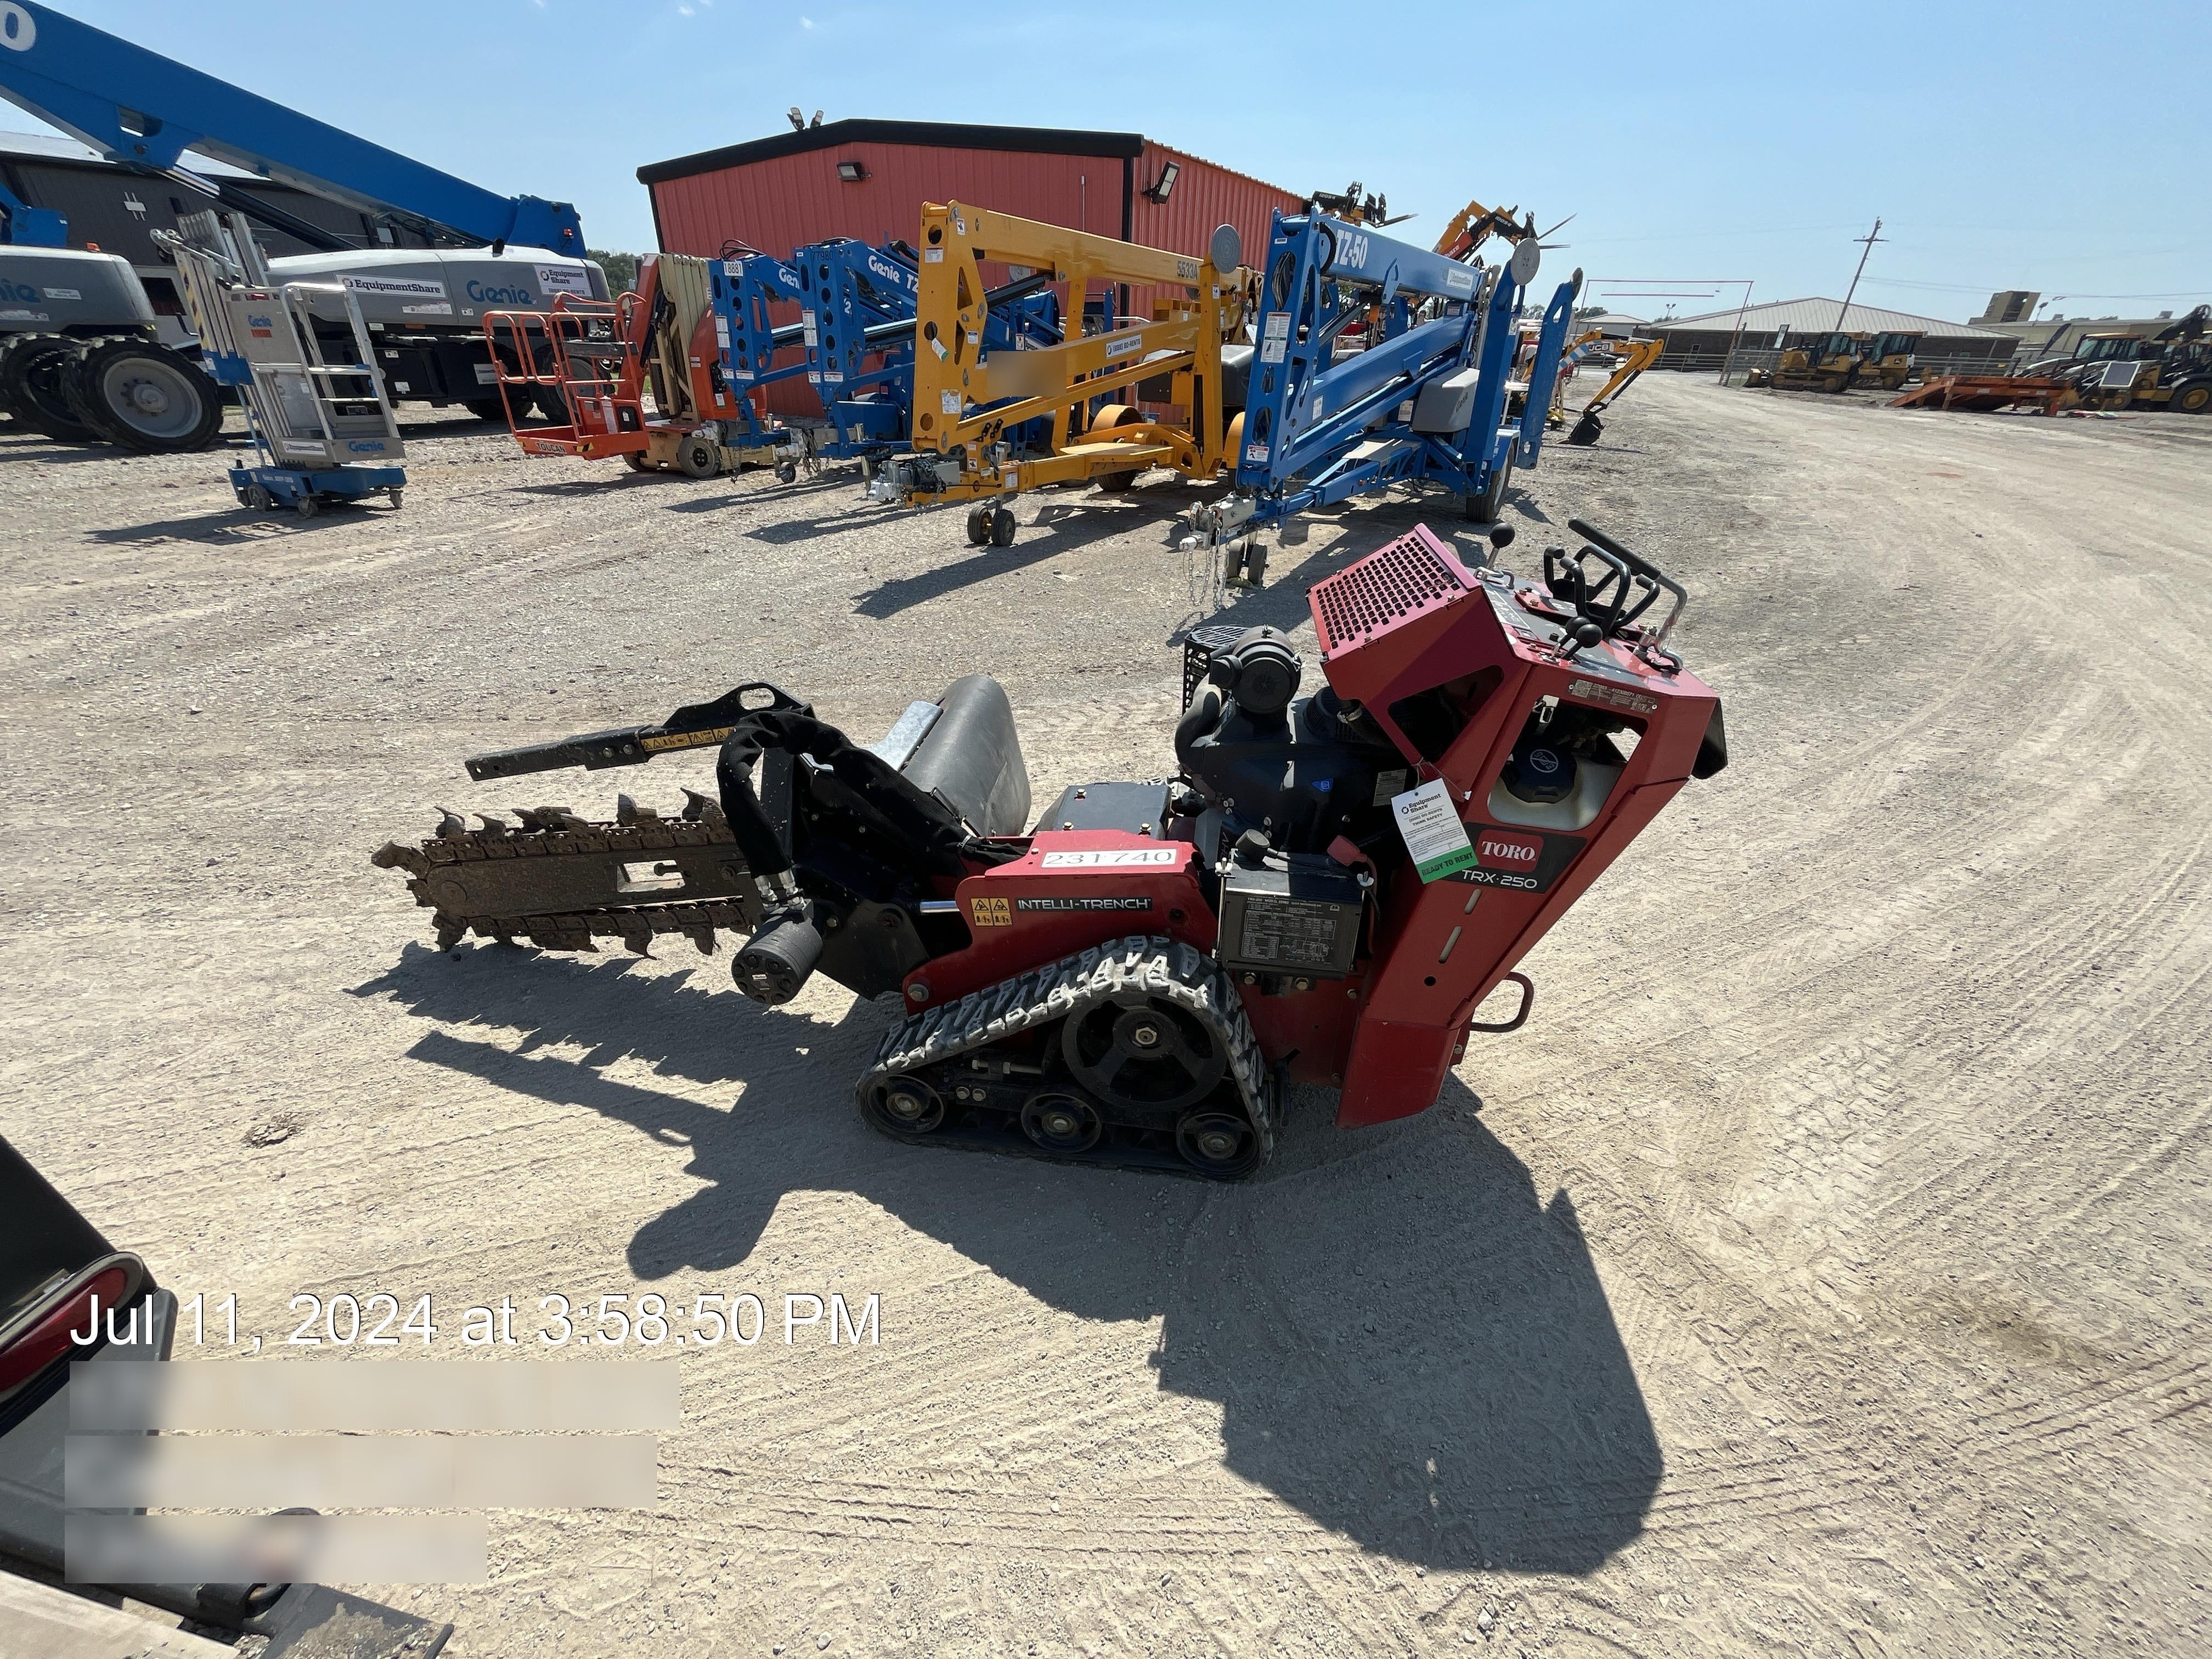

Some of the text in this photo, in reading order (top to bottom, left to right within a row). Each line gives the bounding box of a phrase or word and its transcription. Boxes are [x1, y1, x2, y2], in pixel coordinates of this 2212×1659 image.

[1334, 229, 1368, 270] TZ-50
[549, 269, 584, 278] Equipment
[724, 262, 743, 274] 18881
[868, 255, 901, 284] Genie
[354, 279, 441, 294] EquipmentShare
[466, 280, 533, 305] Genie
[348, 441, 386, 452] Genie
[536, 442, 566, 453] TOUCAN
[1408, 793, 1442, 809] Equipment
[1410, 804, 1429, 814] Share
[1427, 812, 1443, 821] SAFETY
[1481, 841, 1536, 861] TORO
[1046, 852, 1172, 865] 231740
[1421, 863, 1443, 877] READY
[1455, 851, 1474, 864] RENT
[1018, 899, 1149, 910] INTELLI-TRENCH
